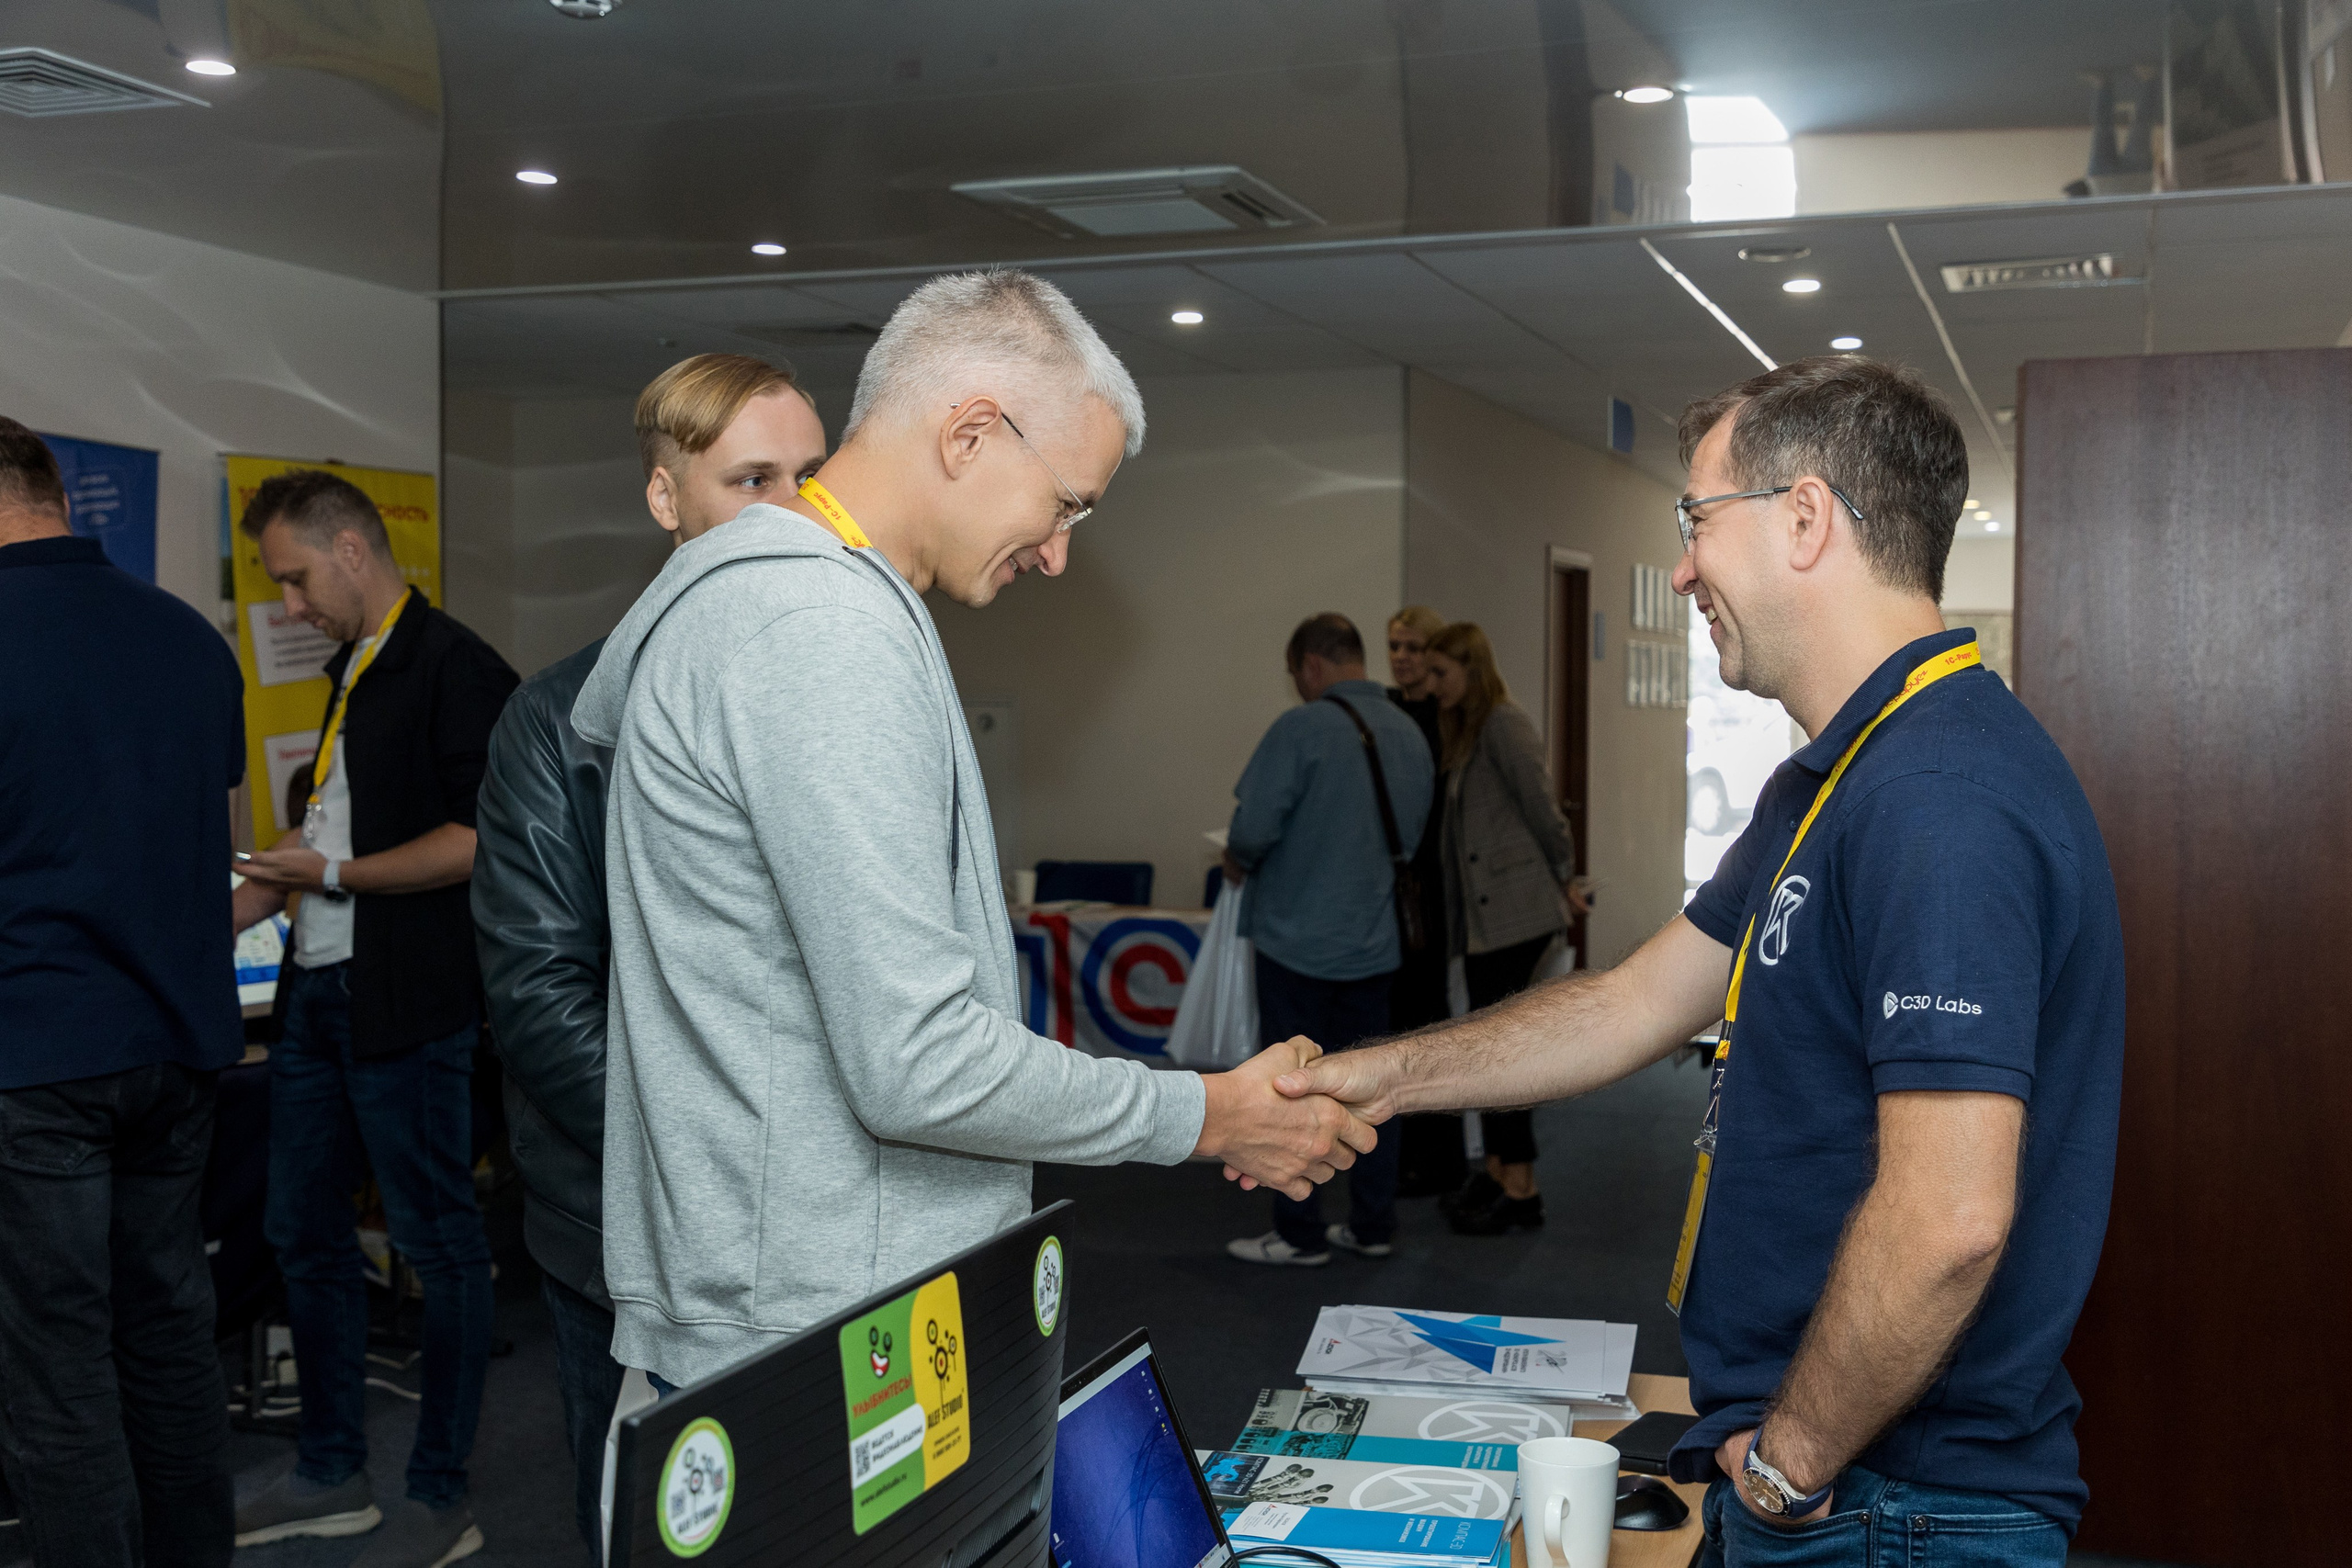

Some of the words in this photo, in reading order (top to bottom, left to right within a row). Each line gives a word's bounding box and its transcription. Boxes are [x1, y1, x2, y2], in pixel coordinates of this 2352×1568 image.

[1900, 995, 1931, 1010] C3D
[1935, 995, 1983, 1015] Labs
[927, 1407, 941, 1430] ALEF
